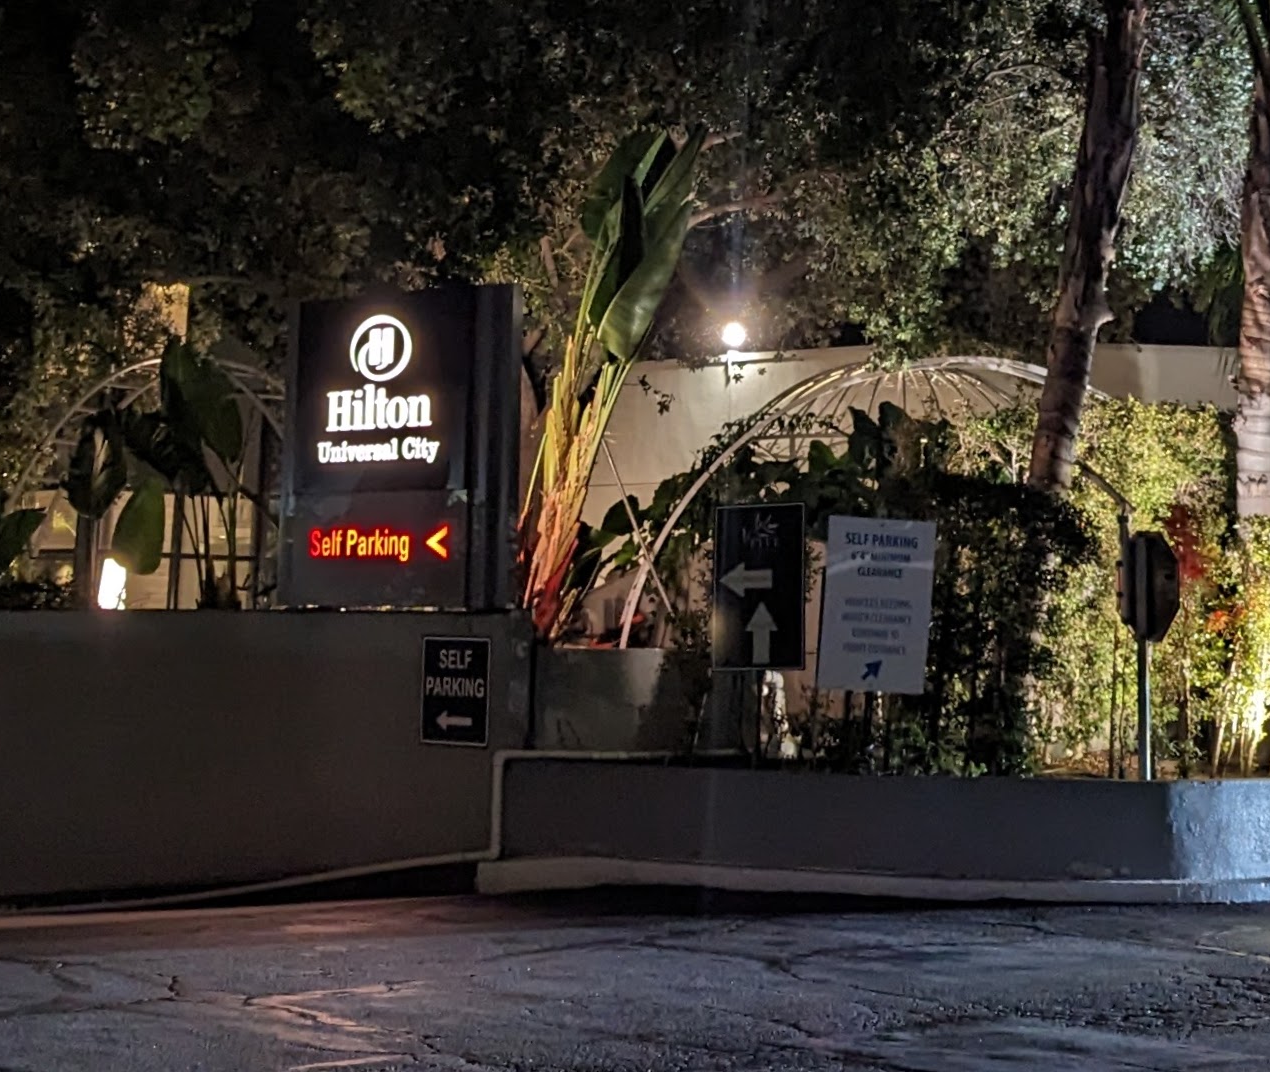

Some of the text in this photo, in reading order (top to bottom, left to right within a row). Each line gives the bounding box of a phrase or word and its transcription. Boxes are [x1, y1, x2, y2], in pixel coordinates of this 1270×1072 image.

[325, 383, 433, 432] Hilton
[317, 436, 440, 463] Universal City
[310, 528, 409, 562] Self Parking
[845, 531, 919, 549] SELF PARKING
[439, 649, 473, 669] SELF
[425, 675, 485, 698] PARKING
